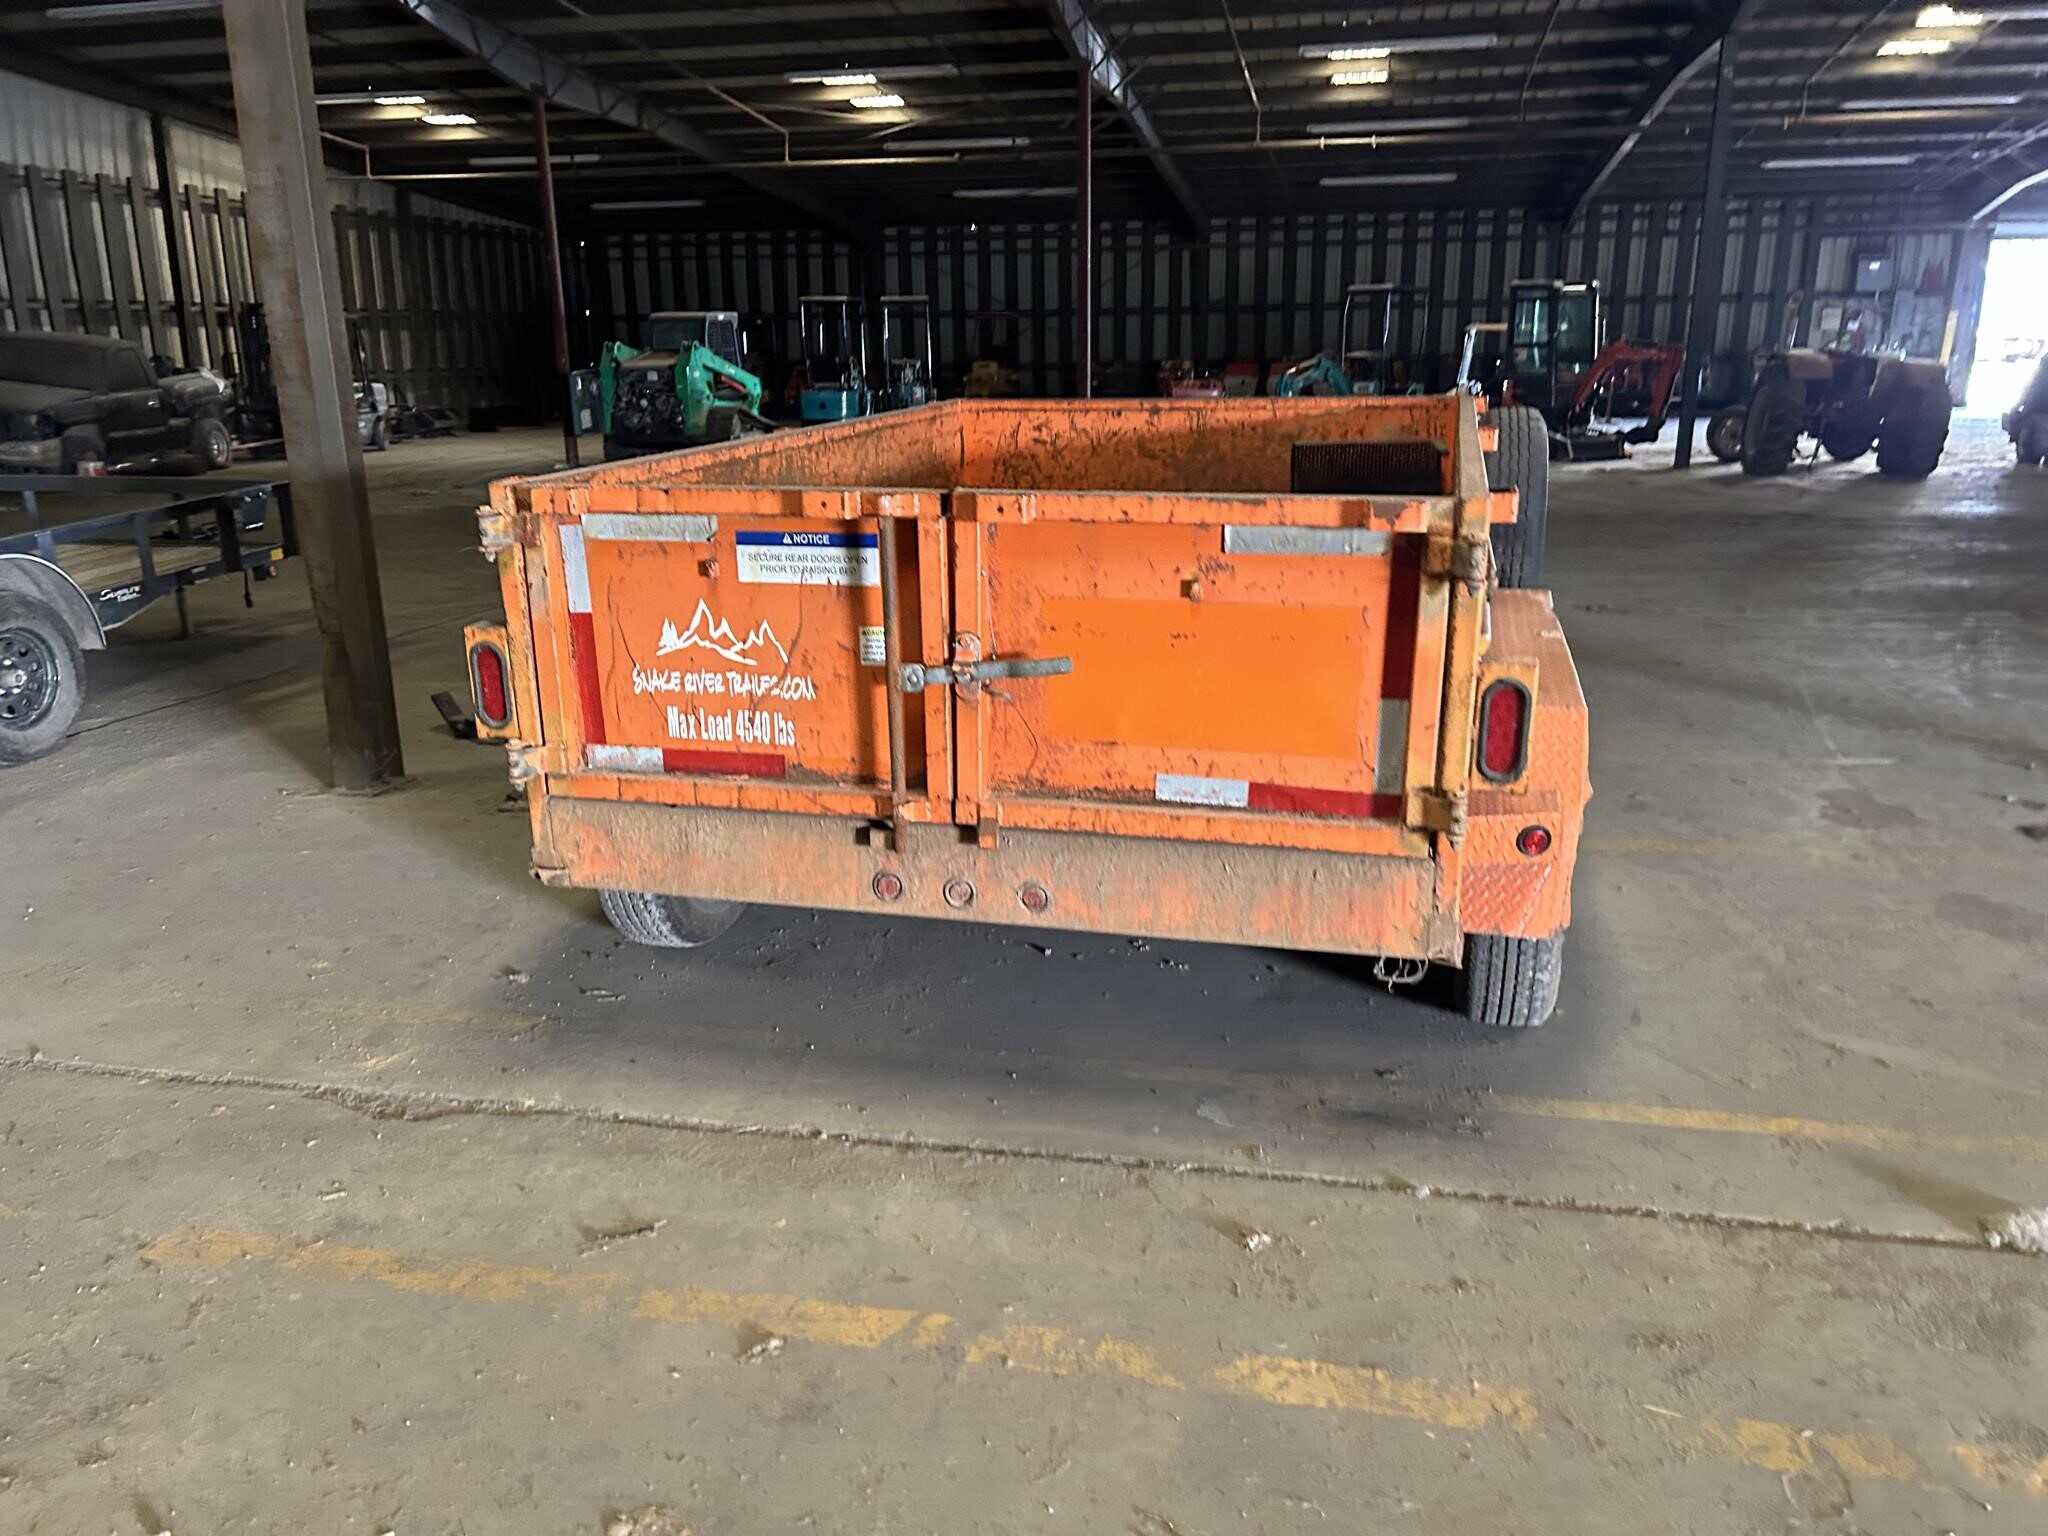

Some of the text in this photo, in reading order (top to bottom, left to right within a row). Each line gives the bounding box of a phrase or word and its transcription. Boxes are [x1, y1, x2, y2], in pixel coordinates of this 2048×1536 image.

[793, 533, 831, 545] NOTICE
[748, 551, 782, 562] SECURE
[785, 553, 809, 563] REAR
[811, 554, 841, 564] DOORS
[760, 564, 787, 574] PRIOR
[789, 565, 801, 574] TO
[802, 565, 838, 575] RAISING
[632, 666, 681, 695] SNAKE
[684, 668, 726, 696] RIVER
[666, 704, 796, 747] Max Load 4540 lbs
